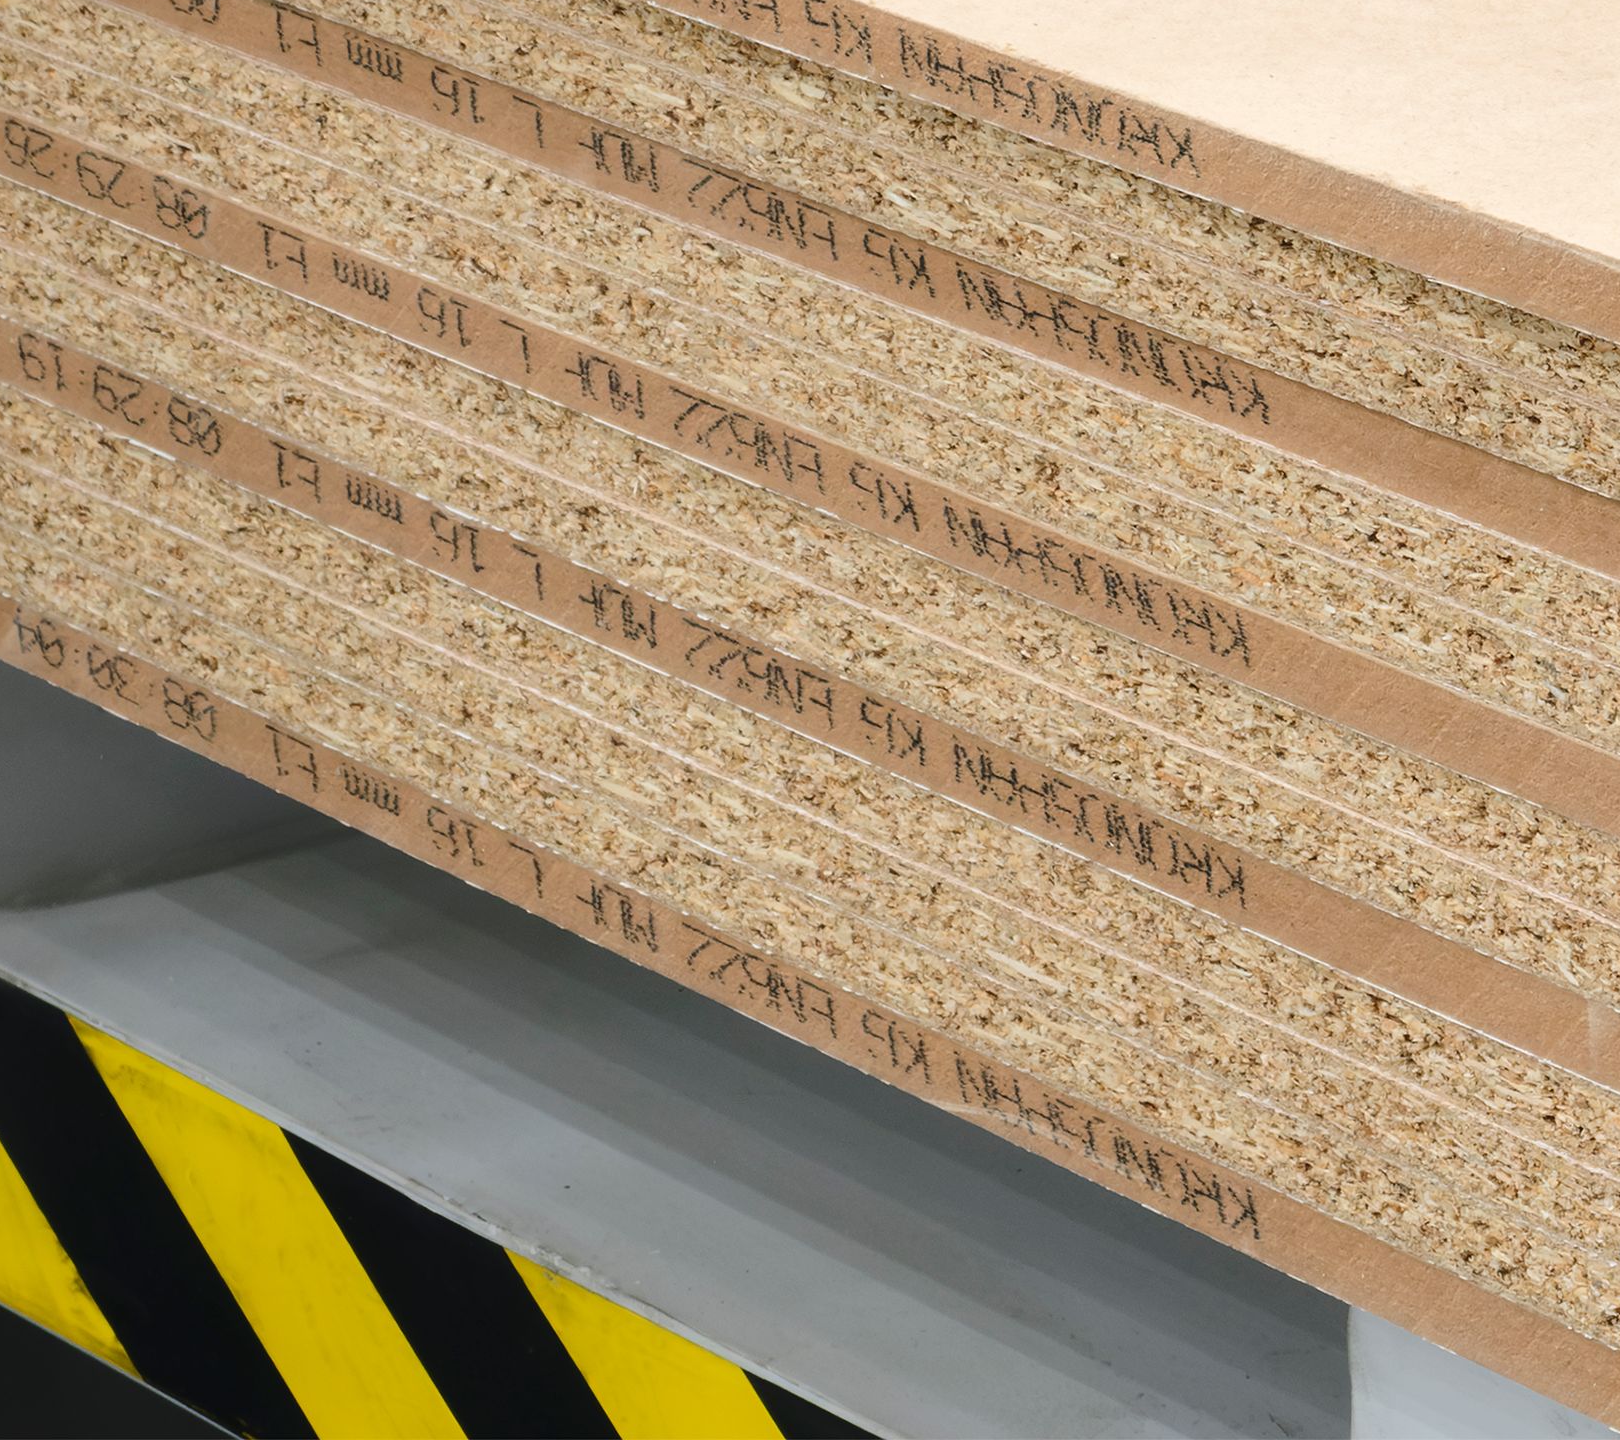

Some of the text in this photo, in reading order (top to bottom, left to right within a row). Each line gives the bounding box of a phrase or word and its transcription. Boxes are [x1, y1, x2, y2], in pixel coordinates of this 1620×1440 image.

[270, 2, 323, 68] E1
[342, 30, 404, 85] mm
[430, 64, 486, 125] 16
[511, 93, 544, 150] L
[3, 117, 212, 241] 08:29:26
[256, 219, 309, 285] E1
[331, 250, 391, 303] mm
[417, 285, 473, 349] 16
[498, 318, 533, 376] L
[17, 331, 224, 458] 08:29:19
[268, 438, 322, 505] E1
[345, 473, 405, 526] mm
[429, 509, 486, 574] 16
[509, 541, 544, 602] L
[264, 723, 320, 794] E1
[341, 761, 400, 818] mm
[426, 804, 486, 868] 16
[507, 839, 545, 901] L
